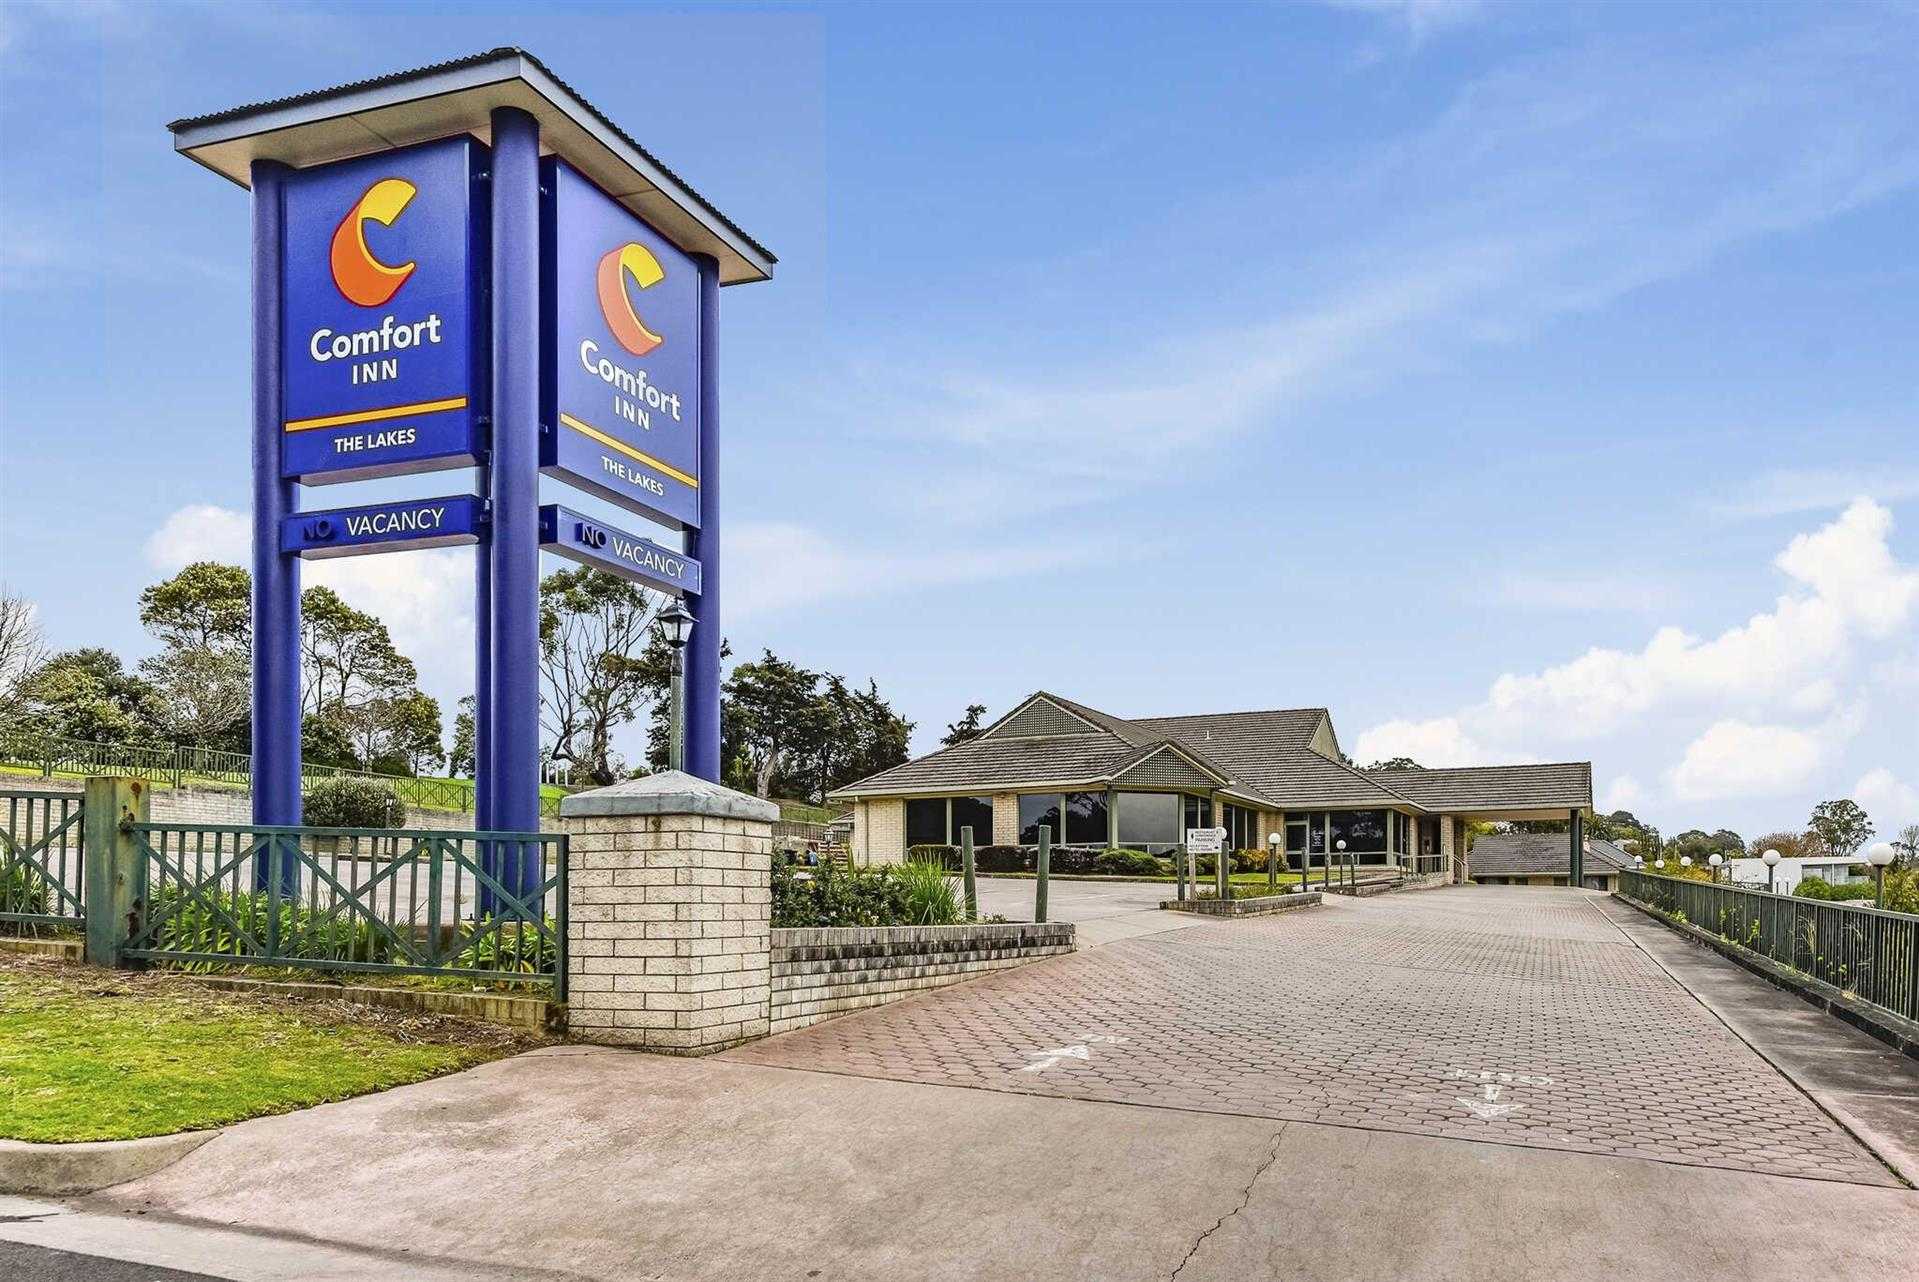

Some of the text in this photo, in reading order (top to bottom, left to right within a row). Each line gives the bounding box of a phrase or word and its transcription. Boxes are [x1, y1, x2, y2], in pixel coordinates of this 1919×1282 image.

[310, 314, 441, 362] Comfort
[352, 358, 398, 385] INN
[580, 339, 681, 422] Comfort
[614, 395, 650, 431] INN
[335, 428, 416, 453] THE LAKES
[601, 456, 664, 496] THE LAKES
[303, 507, 445, 541] NO VACANCY
[580, 523, 685, 579] NO VACANCY
